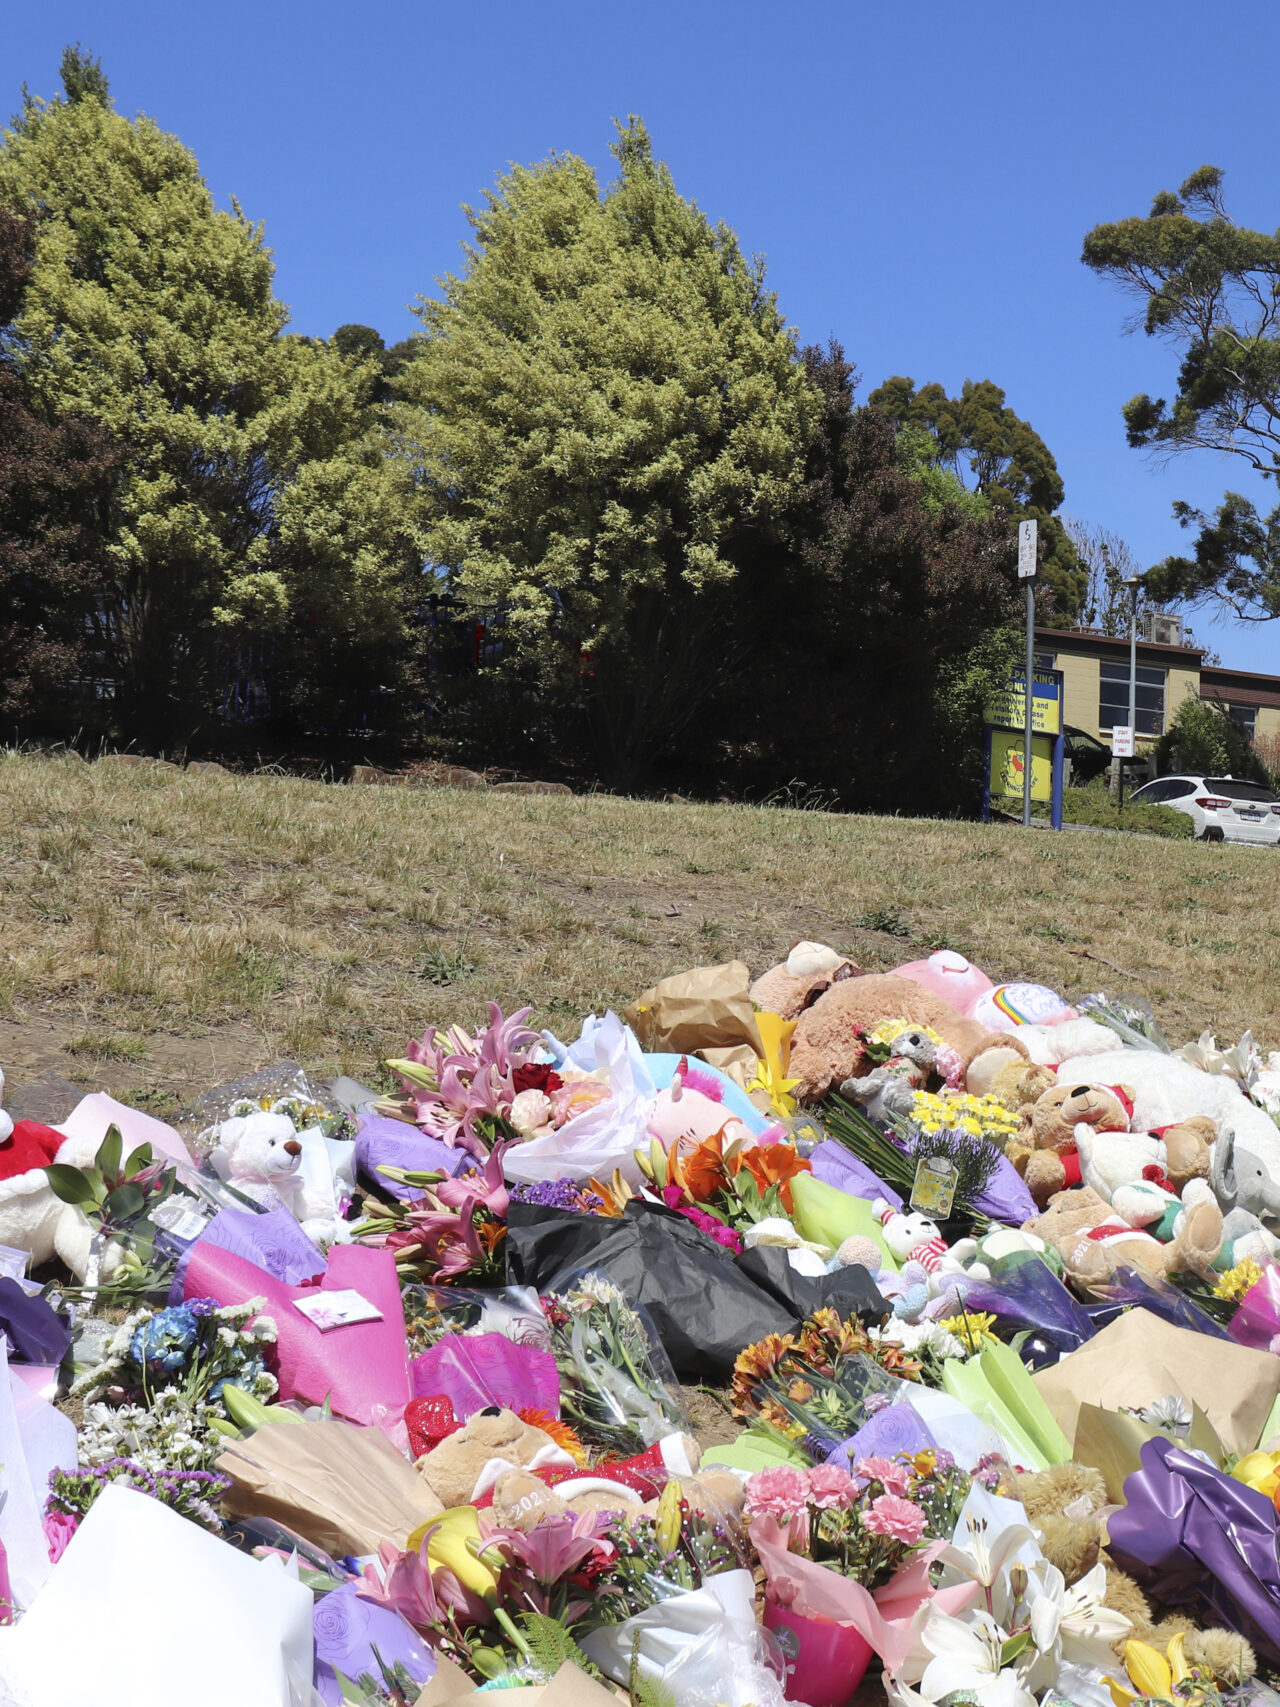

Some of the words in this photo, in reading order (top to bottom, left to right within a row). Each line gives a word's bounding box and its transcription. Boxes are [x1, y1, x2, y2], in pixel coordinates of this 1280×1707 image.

[1014, 670, 1055, 686] PAKING
[1036, 702, 1049, 710] and
[1022, 709, 1044, 719] pase
[1070, 1239, 1092, 1265] 2021
